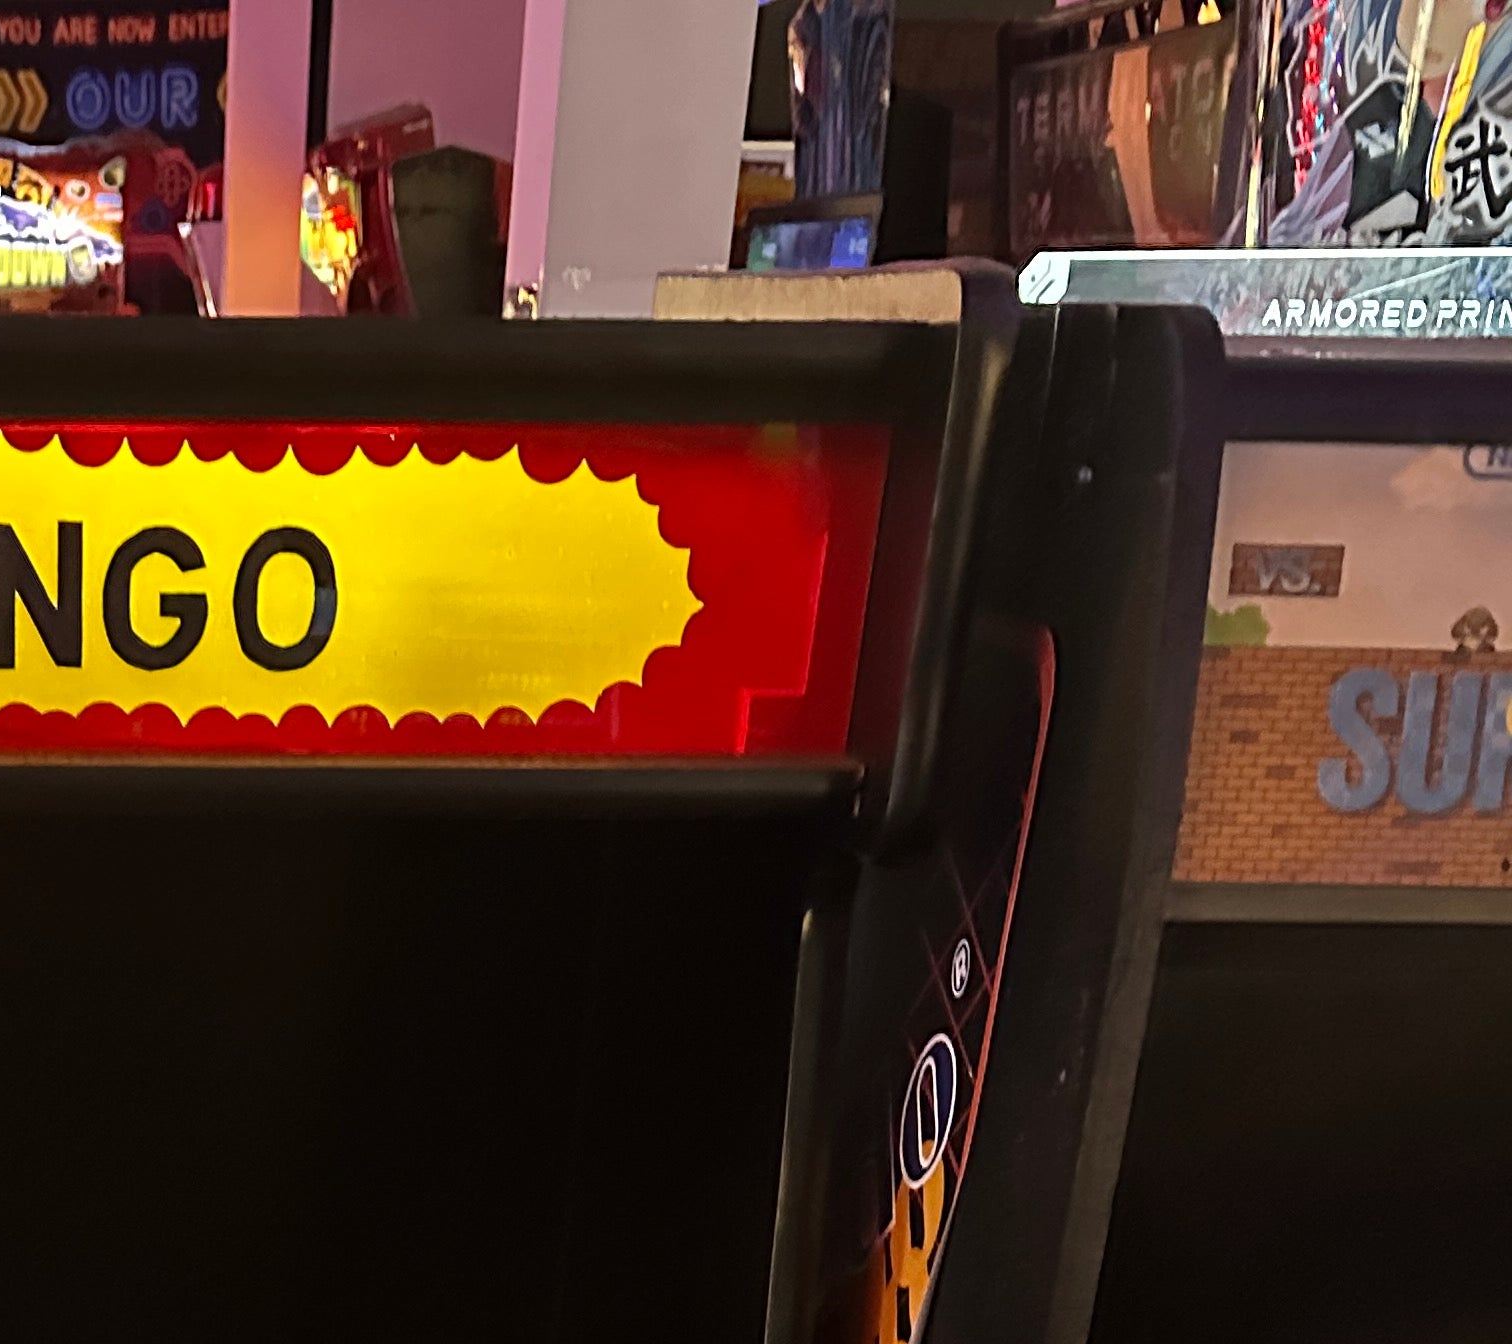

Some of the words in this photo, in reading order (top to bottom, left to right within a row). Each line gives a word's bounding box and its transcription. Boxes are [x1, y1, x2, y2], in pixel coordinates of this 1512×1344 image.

[53, 15, 97, 46] ARE
[108, 15, 156, 44] NOW
[66, 66, 199, 131] OUR
[1261, 298, 1427, 330] ARMORED
